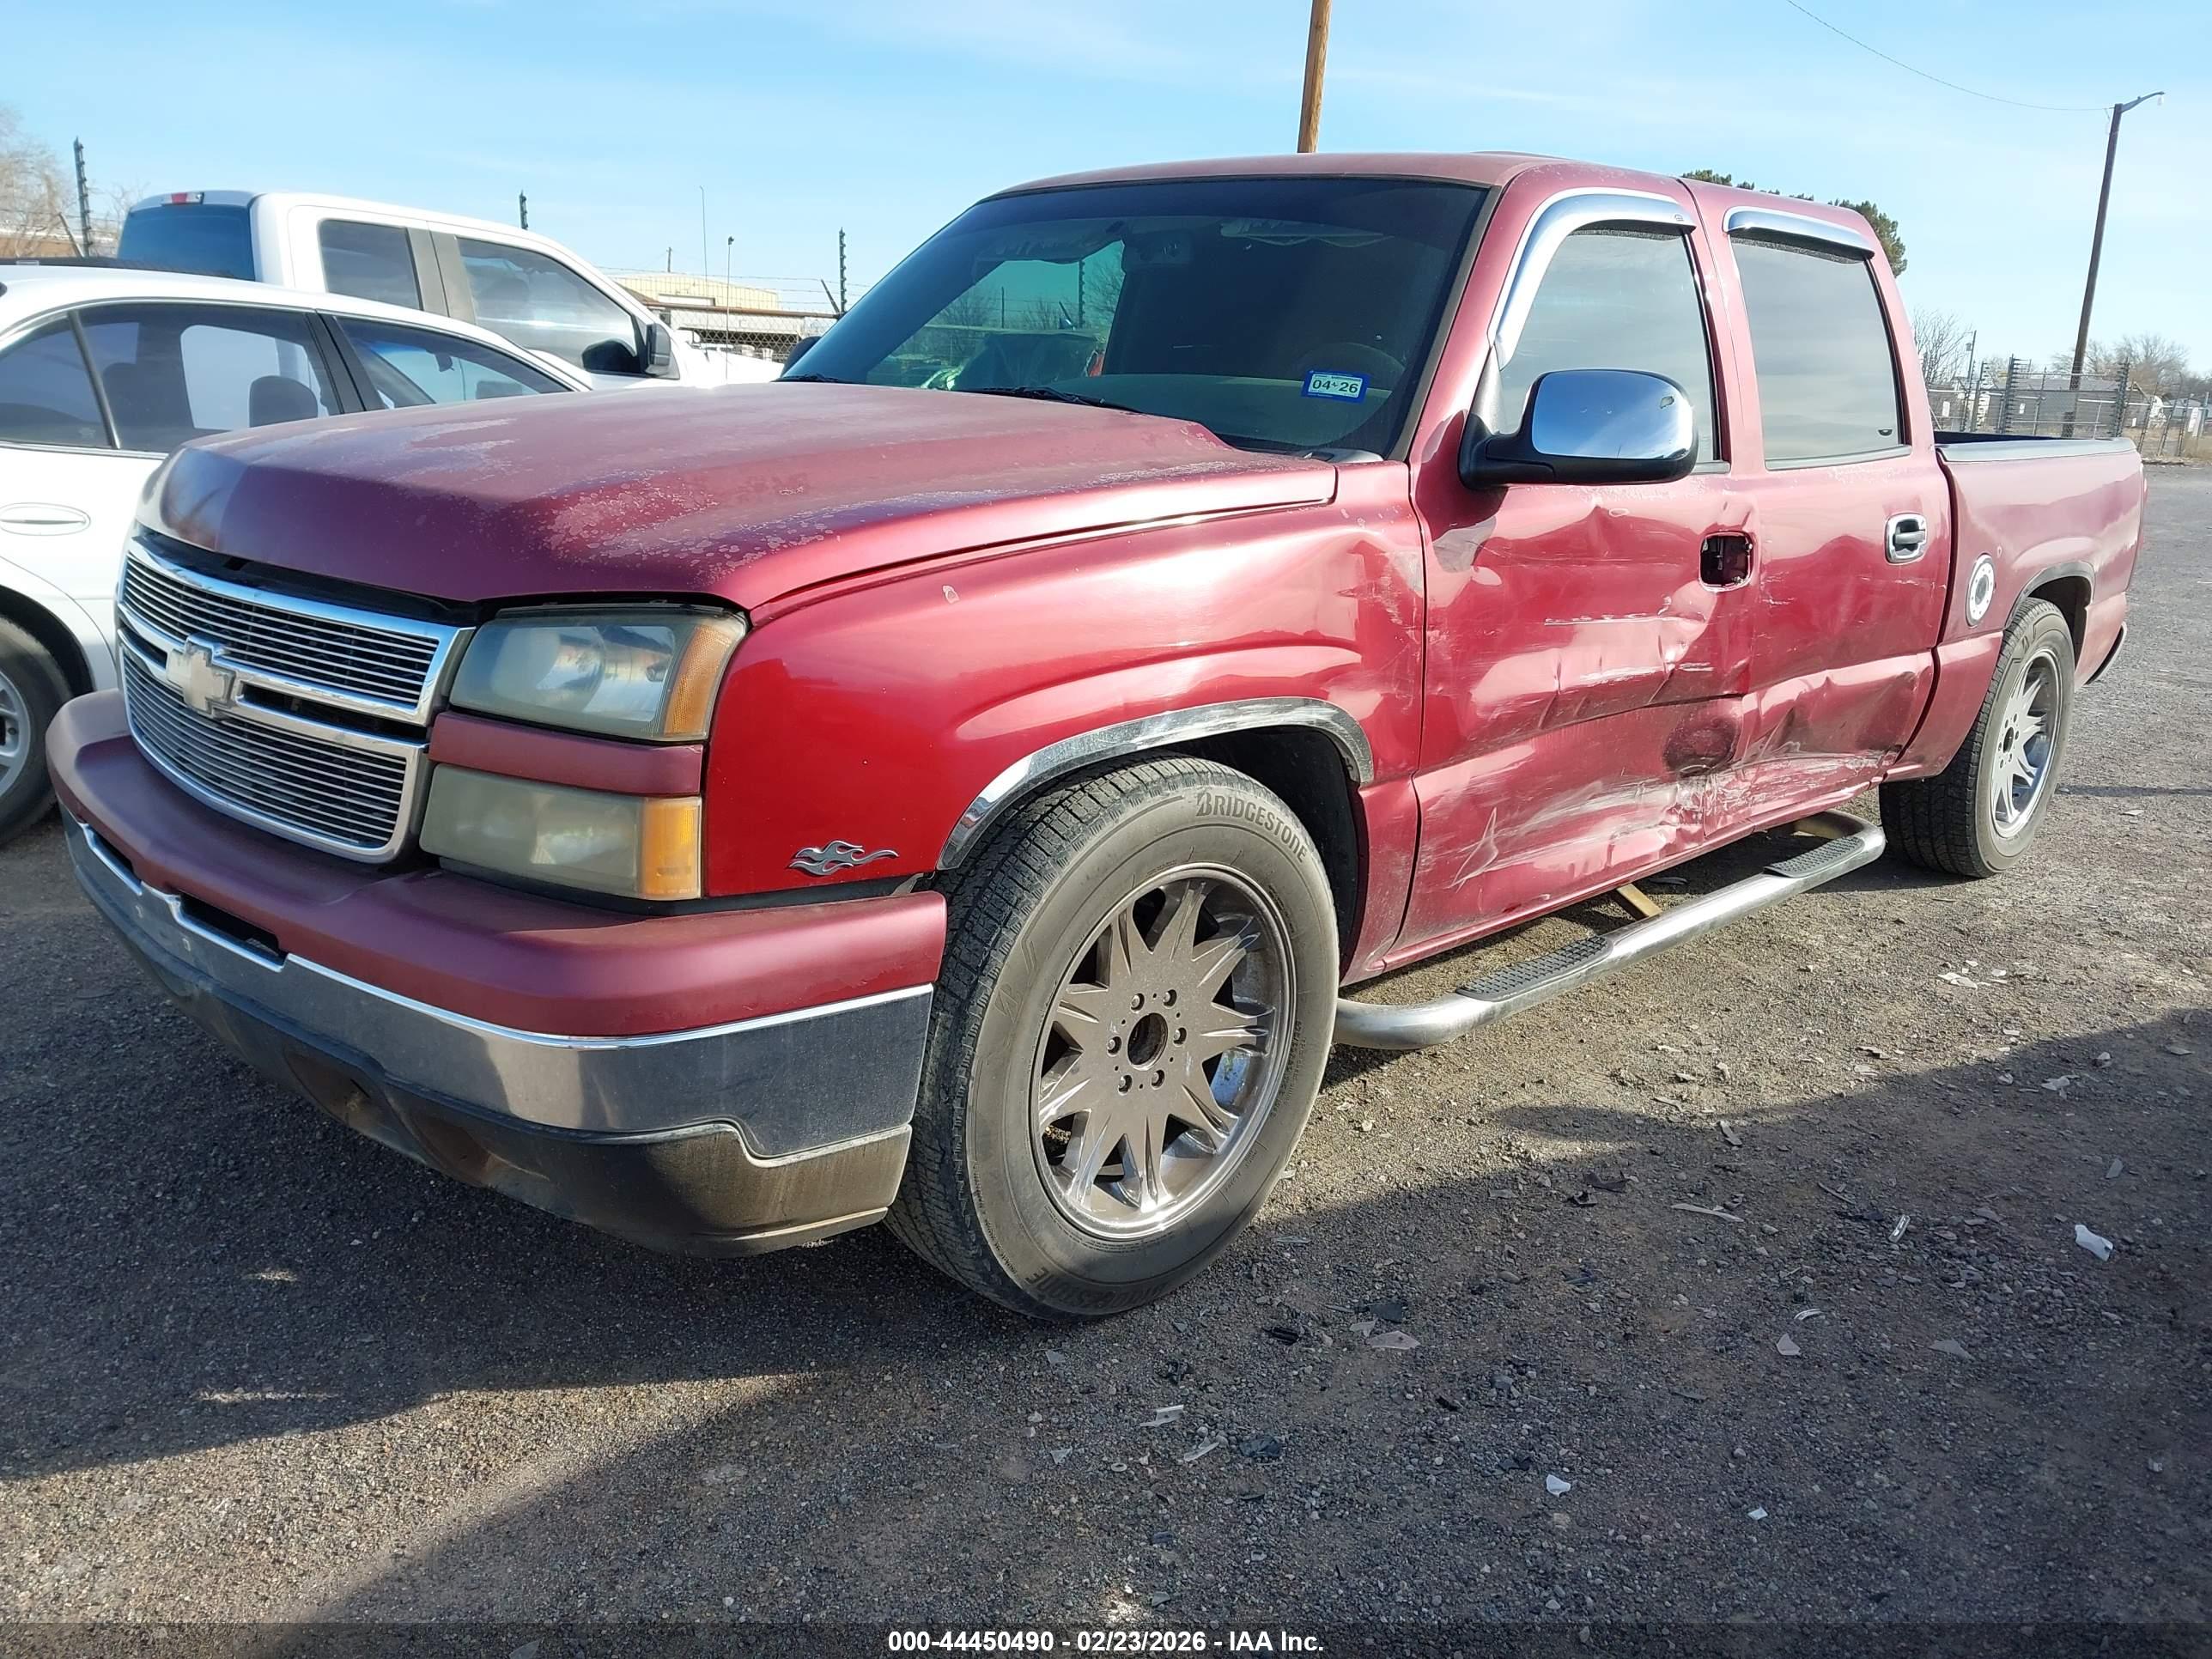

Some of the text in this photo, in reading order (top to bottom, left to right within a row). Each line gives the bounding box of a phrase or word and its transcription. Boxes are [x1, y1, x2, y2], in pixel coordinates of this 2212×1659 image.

[1312, 380, 1358, 393] 04 26
[1196, 792, 1308, 863] BRIDGESTONE
